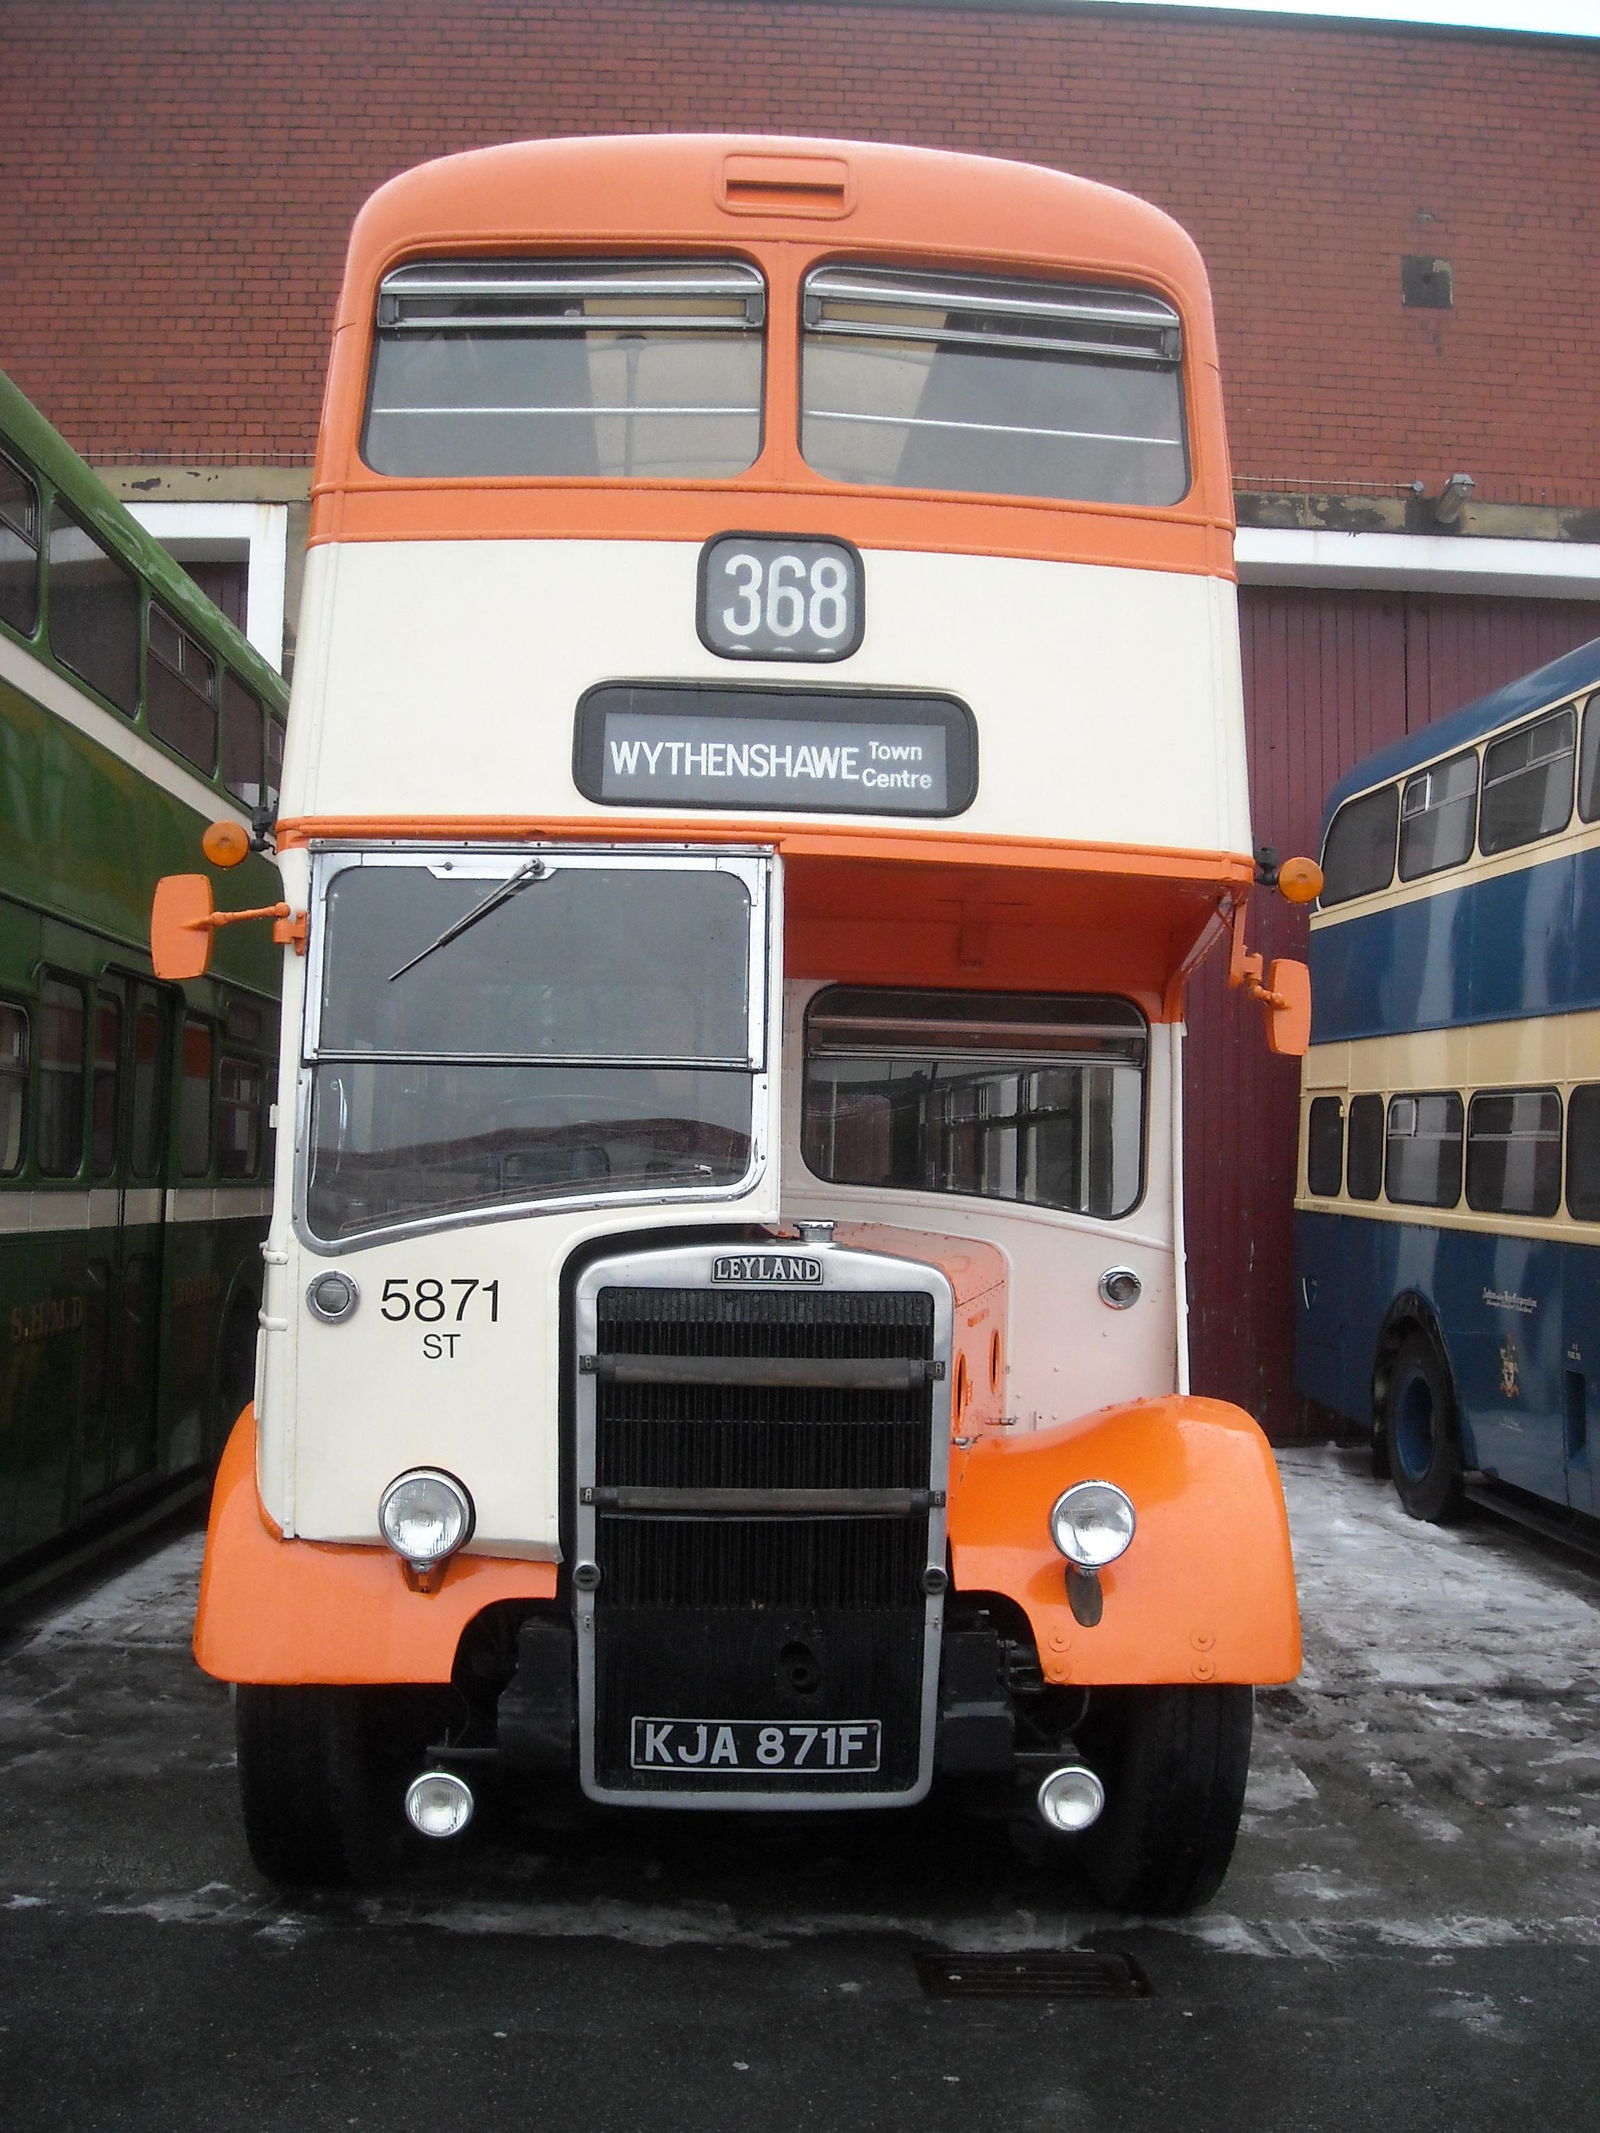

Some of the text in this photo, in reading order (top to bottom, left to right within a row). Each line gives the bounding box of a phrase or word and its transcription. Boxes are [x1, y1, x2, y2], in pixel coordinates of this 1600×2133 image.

[723, 554, 848, 639] 368
[610, 740, 860, 781] WYTHENSHAWE
[868, 741, 923, 761] Town
[862, 768, 932, 789] Centre
[715, 1256, 821, 1284] LEYLAND
[380, 1279, 499, 1322] 5871
[422, 1333, 461, 1360] ST
[644, 1723, 868, 1766] KJA 871F
